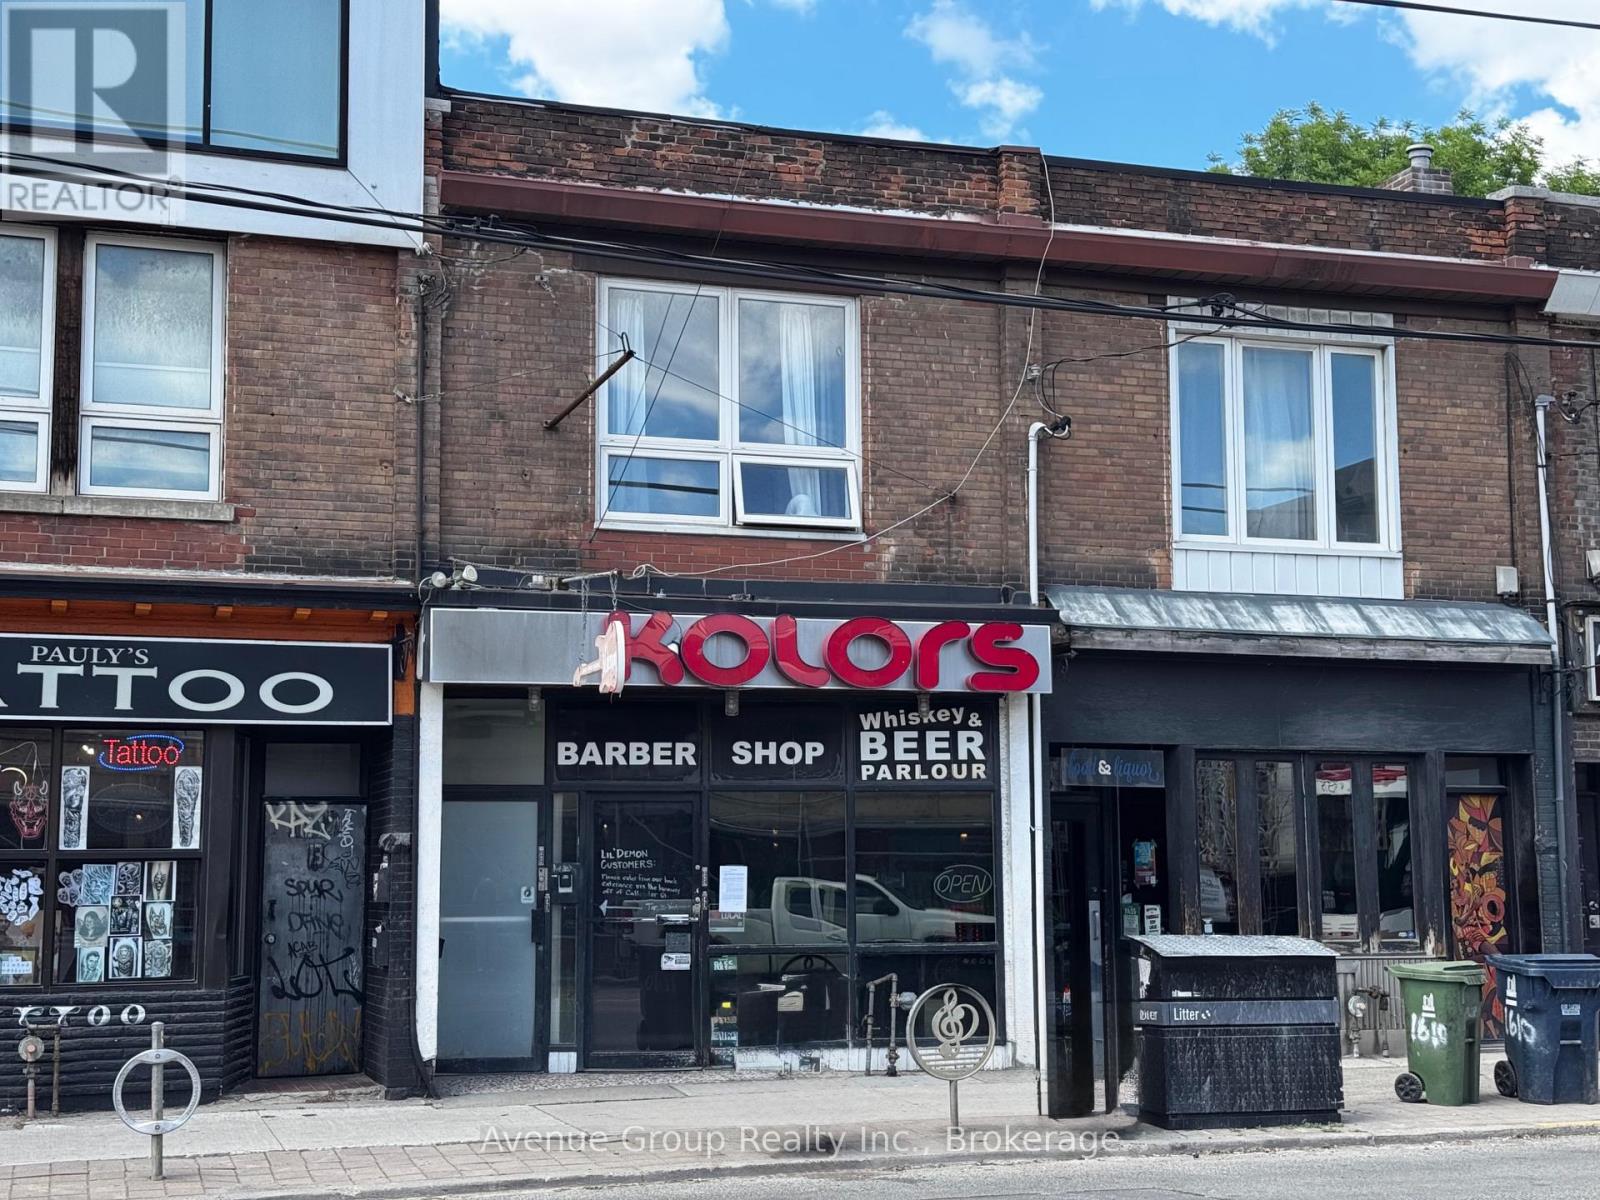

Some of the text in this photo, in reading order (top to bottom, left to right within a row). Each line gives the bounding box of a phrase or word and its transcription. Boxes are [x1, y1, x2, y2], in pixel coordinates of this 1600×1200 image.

[31, 645, 149, 665] PAULY'S
[860, 707, 983, 731] Whiskey &
[104, 739, 180, 765] Tattoo
[557, 741, 825, 766] BARBER SHOP
[860, 731, 986, 761] BEER
[860, 763, 987, 781] PARLOUR
[1098, 760, 1112, 775] &
[616, 848, 648, 859] DEMON
[600, 859, 656, 870] CUSTOMERS:
[937, 874, 986, 893] OPEN
[1173, 1007, 1200, 1021] Litter
